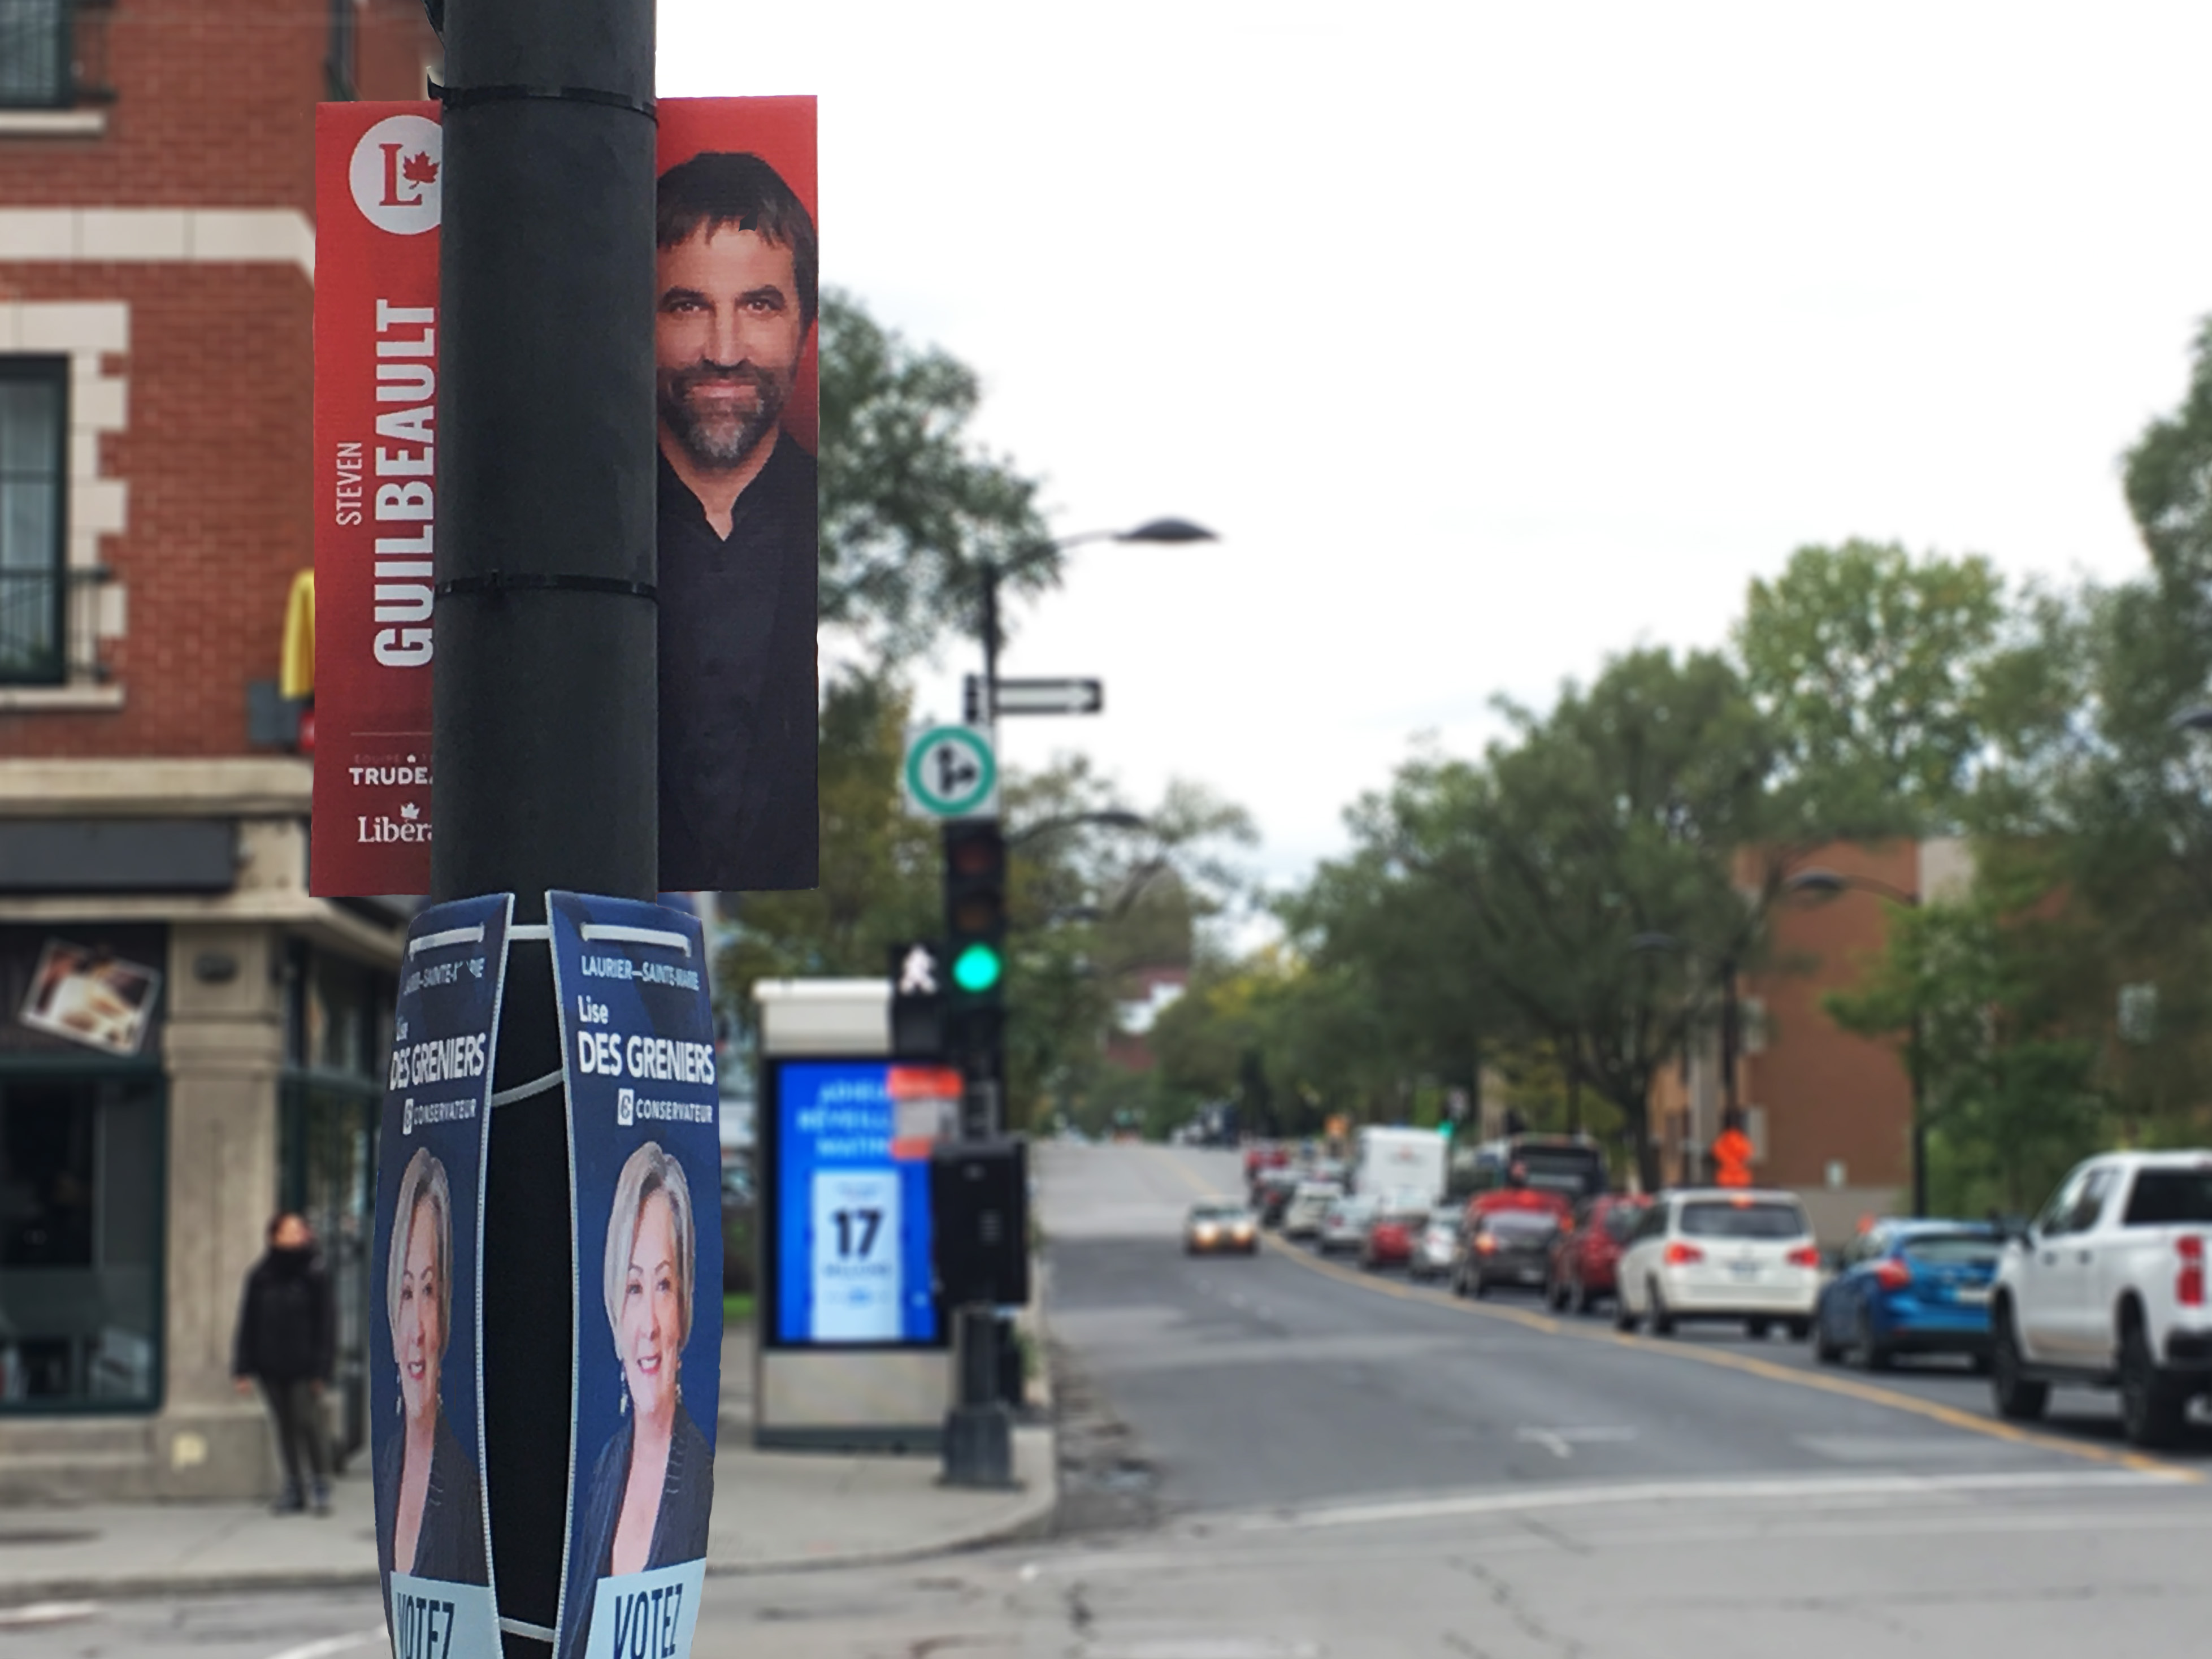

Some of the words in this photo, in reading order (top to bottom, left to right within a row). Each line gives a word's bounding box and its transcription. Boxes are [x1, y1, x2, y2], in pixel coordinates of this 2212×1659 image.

[336, 442, 362, 526] STEVEN
[374, 298, 435, 667] GUILBEAULT
[578, 995, 609, 1024] Lise
[390, 1047, 411, 1090] DES
[411, 1032, 486, 1085] GRENIERS
[578, 1030, 622, 1076] DES
[627, 1036, 715, 1085] GRENIERS
[636, 1098, 713, 1123] CONSERVATEUR
[830, 1208, 883, 1259] 17
[614, 1583, 683, 1659] VOTEZ
